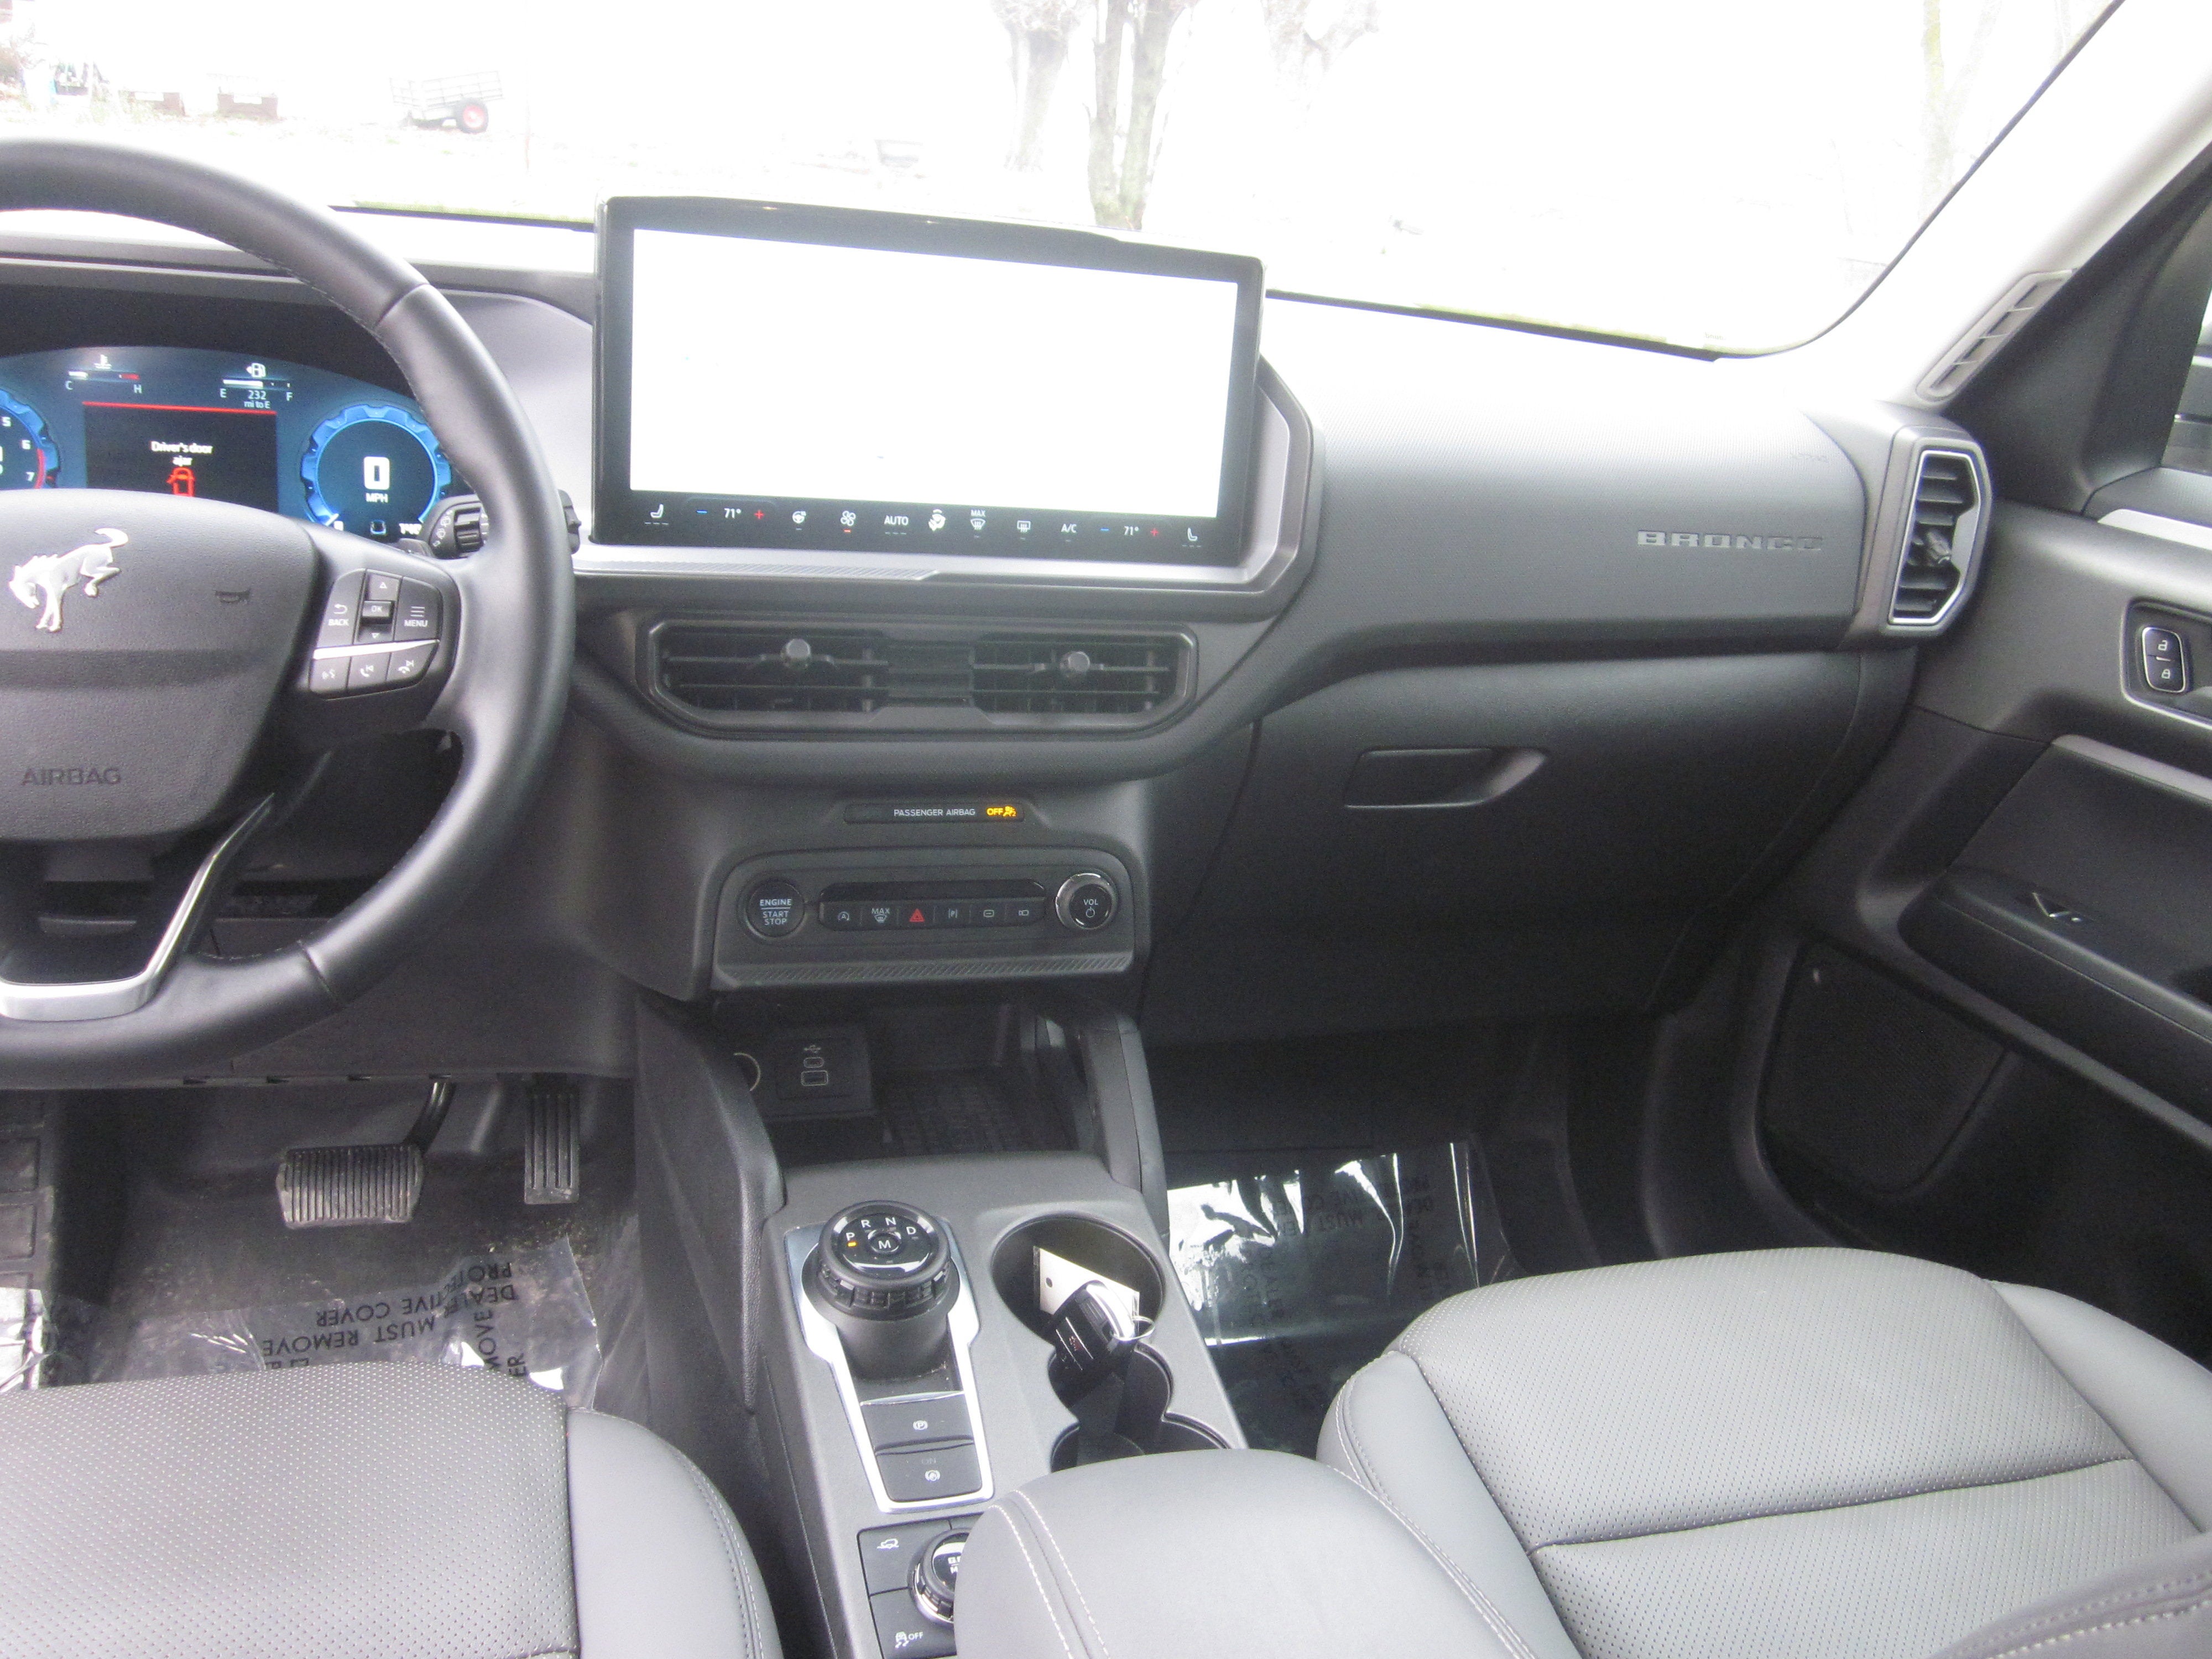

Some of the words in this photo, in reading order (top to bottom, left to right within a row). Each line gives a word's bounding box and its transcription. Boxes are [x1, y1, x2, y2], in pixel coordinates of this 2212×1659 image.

[133, 384, 142, 393] H
[220, 388, 227, 398] E
[248, 390, 267, 400] 232
[286, 392, 293, 401] F
[21, 440, 31, 450] 6
[189, 442, 214, 454] door
[172, 455, 193, 467] ajar
[26, 472, 35, 482] 7
[363, 456, 390, 490] 0
[366, 492, 388, 503] MPH
[970, 509, 987, 518] MAX
[884, 514, 909, 526] AUTO
[1060, 523, 1077, 534] A/C
[1636, 529, 1823, 551] BRONCO
[371, 605, 383, 614] OK
[328, 618, 349, 627] BACK
[404, 619, 429, 628] MENU
[20, 767, 122, 786] AIRBAG
[893, 808, 943, 817] PASSENGER
[946, 808, 976, 817] AIRBAG
[986, 807, 1003, 817] OFF
[759, 898, 792, 907] ENGINE
[763, 910, 789, 919] START
[861, 1219, 872, 1229] R
[885, 1217, 896, 1226] N
[906, 1226, 917, 1235] D
[845, 1232, 855, 1241] P
[878, 1239, 891, 1250] M
[316, 1302, 390, 1327] COVER
[374, 1314, 436, 1343] MUST
[262, 1329, 359, 1357] REMOVE
[473, 1309, 502, 1370] MOVE
[908, 1631, 924, 1641] OFF
